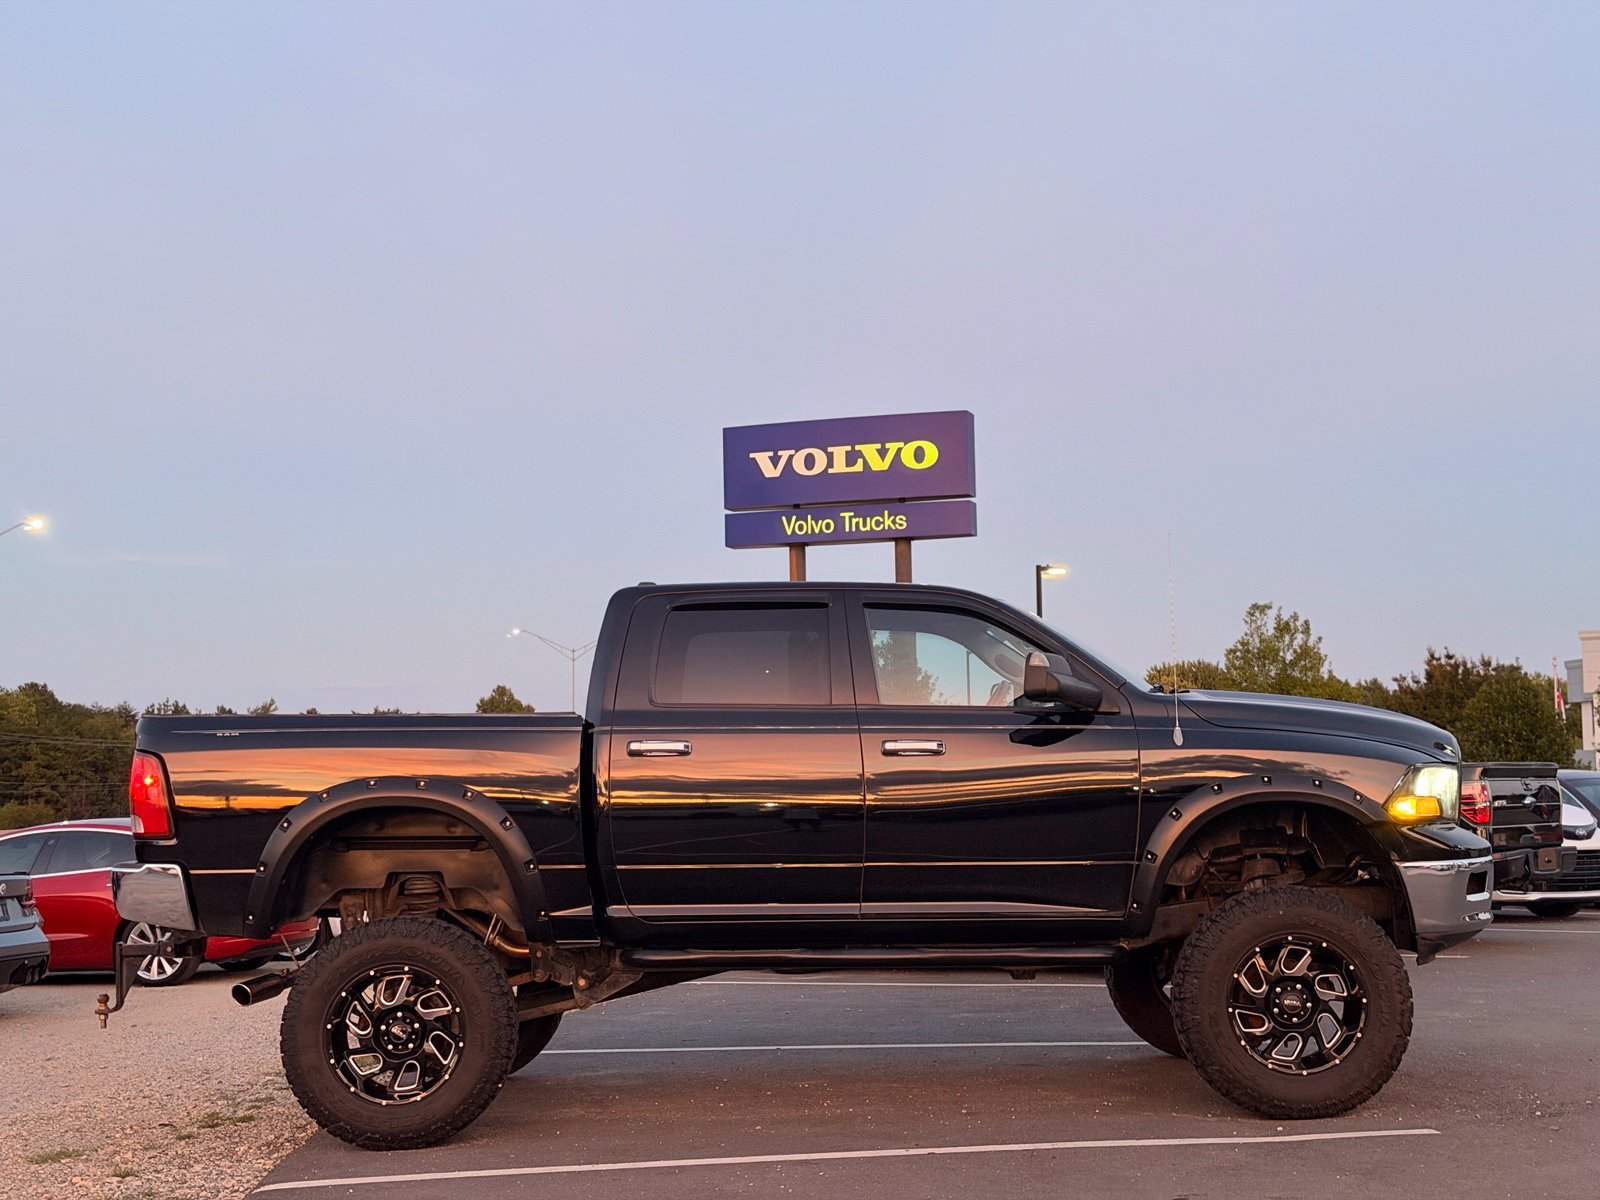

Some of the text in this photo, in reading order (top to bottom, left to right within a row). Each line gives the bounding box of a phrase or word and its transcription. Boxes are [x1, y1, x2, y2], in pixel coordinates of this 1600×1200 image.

[750, 440, 939, 478] VOLVO
[782, 510, 907, 535] Volvo Trucks
